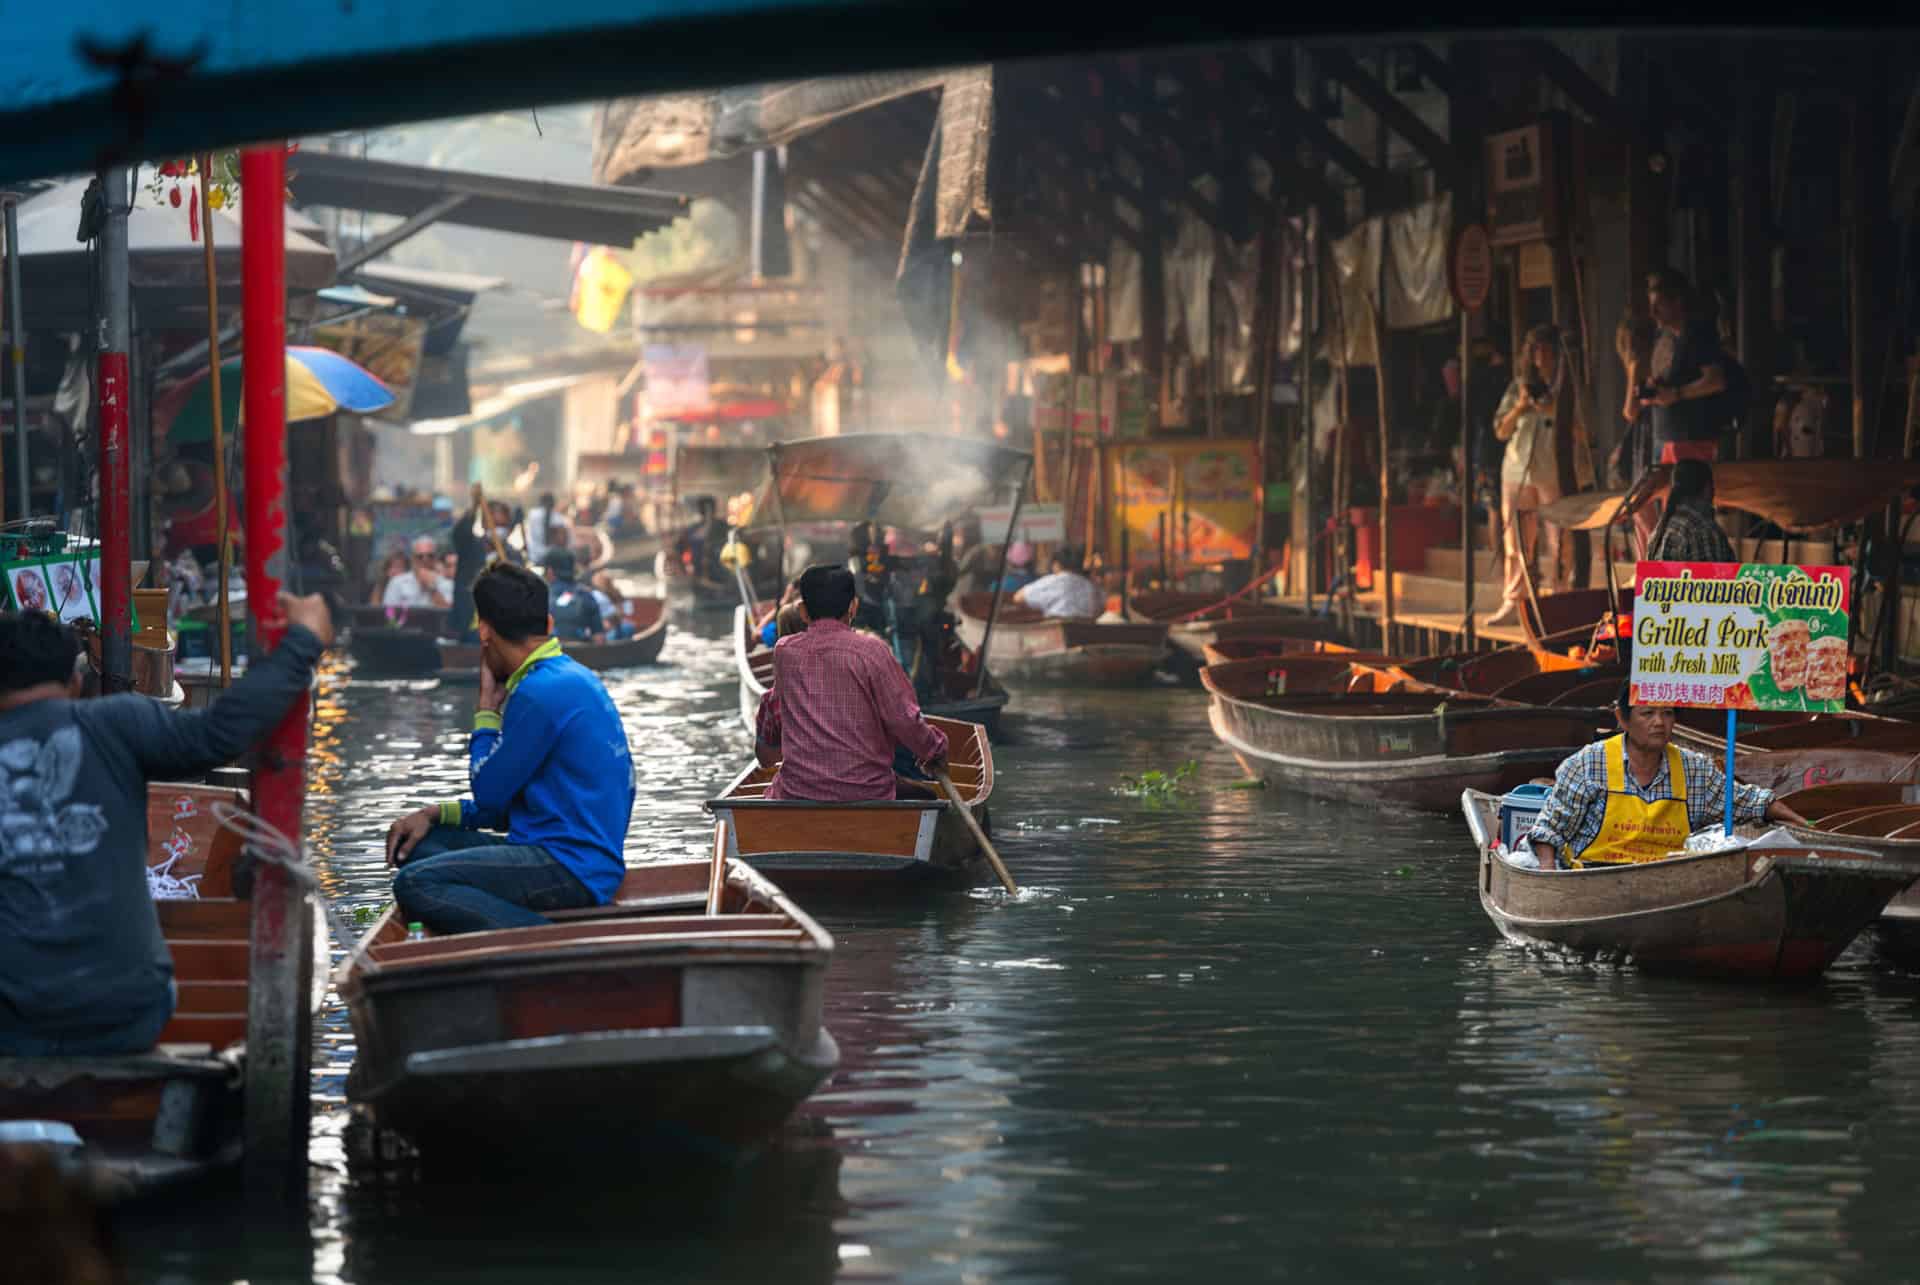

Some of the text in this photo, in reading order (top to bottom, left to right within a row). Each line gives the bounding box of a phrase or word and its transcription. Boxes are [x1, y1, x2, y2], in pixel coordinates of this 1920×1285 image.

[1643, 571, 1762, 613] หมูย่างนมสด
[1637, 617, 1769, 648] Grilled Pork
[1639, 651, 1741, 675] with Fresh Milk
[1639, 682, 1725, 703] 鮮奶烤豬肉
